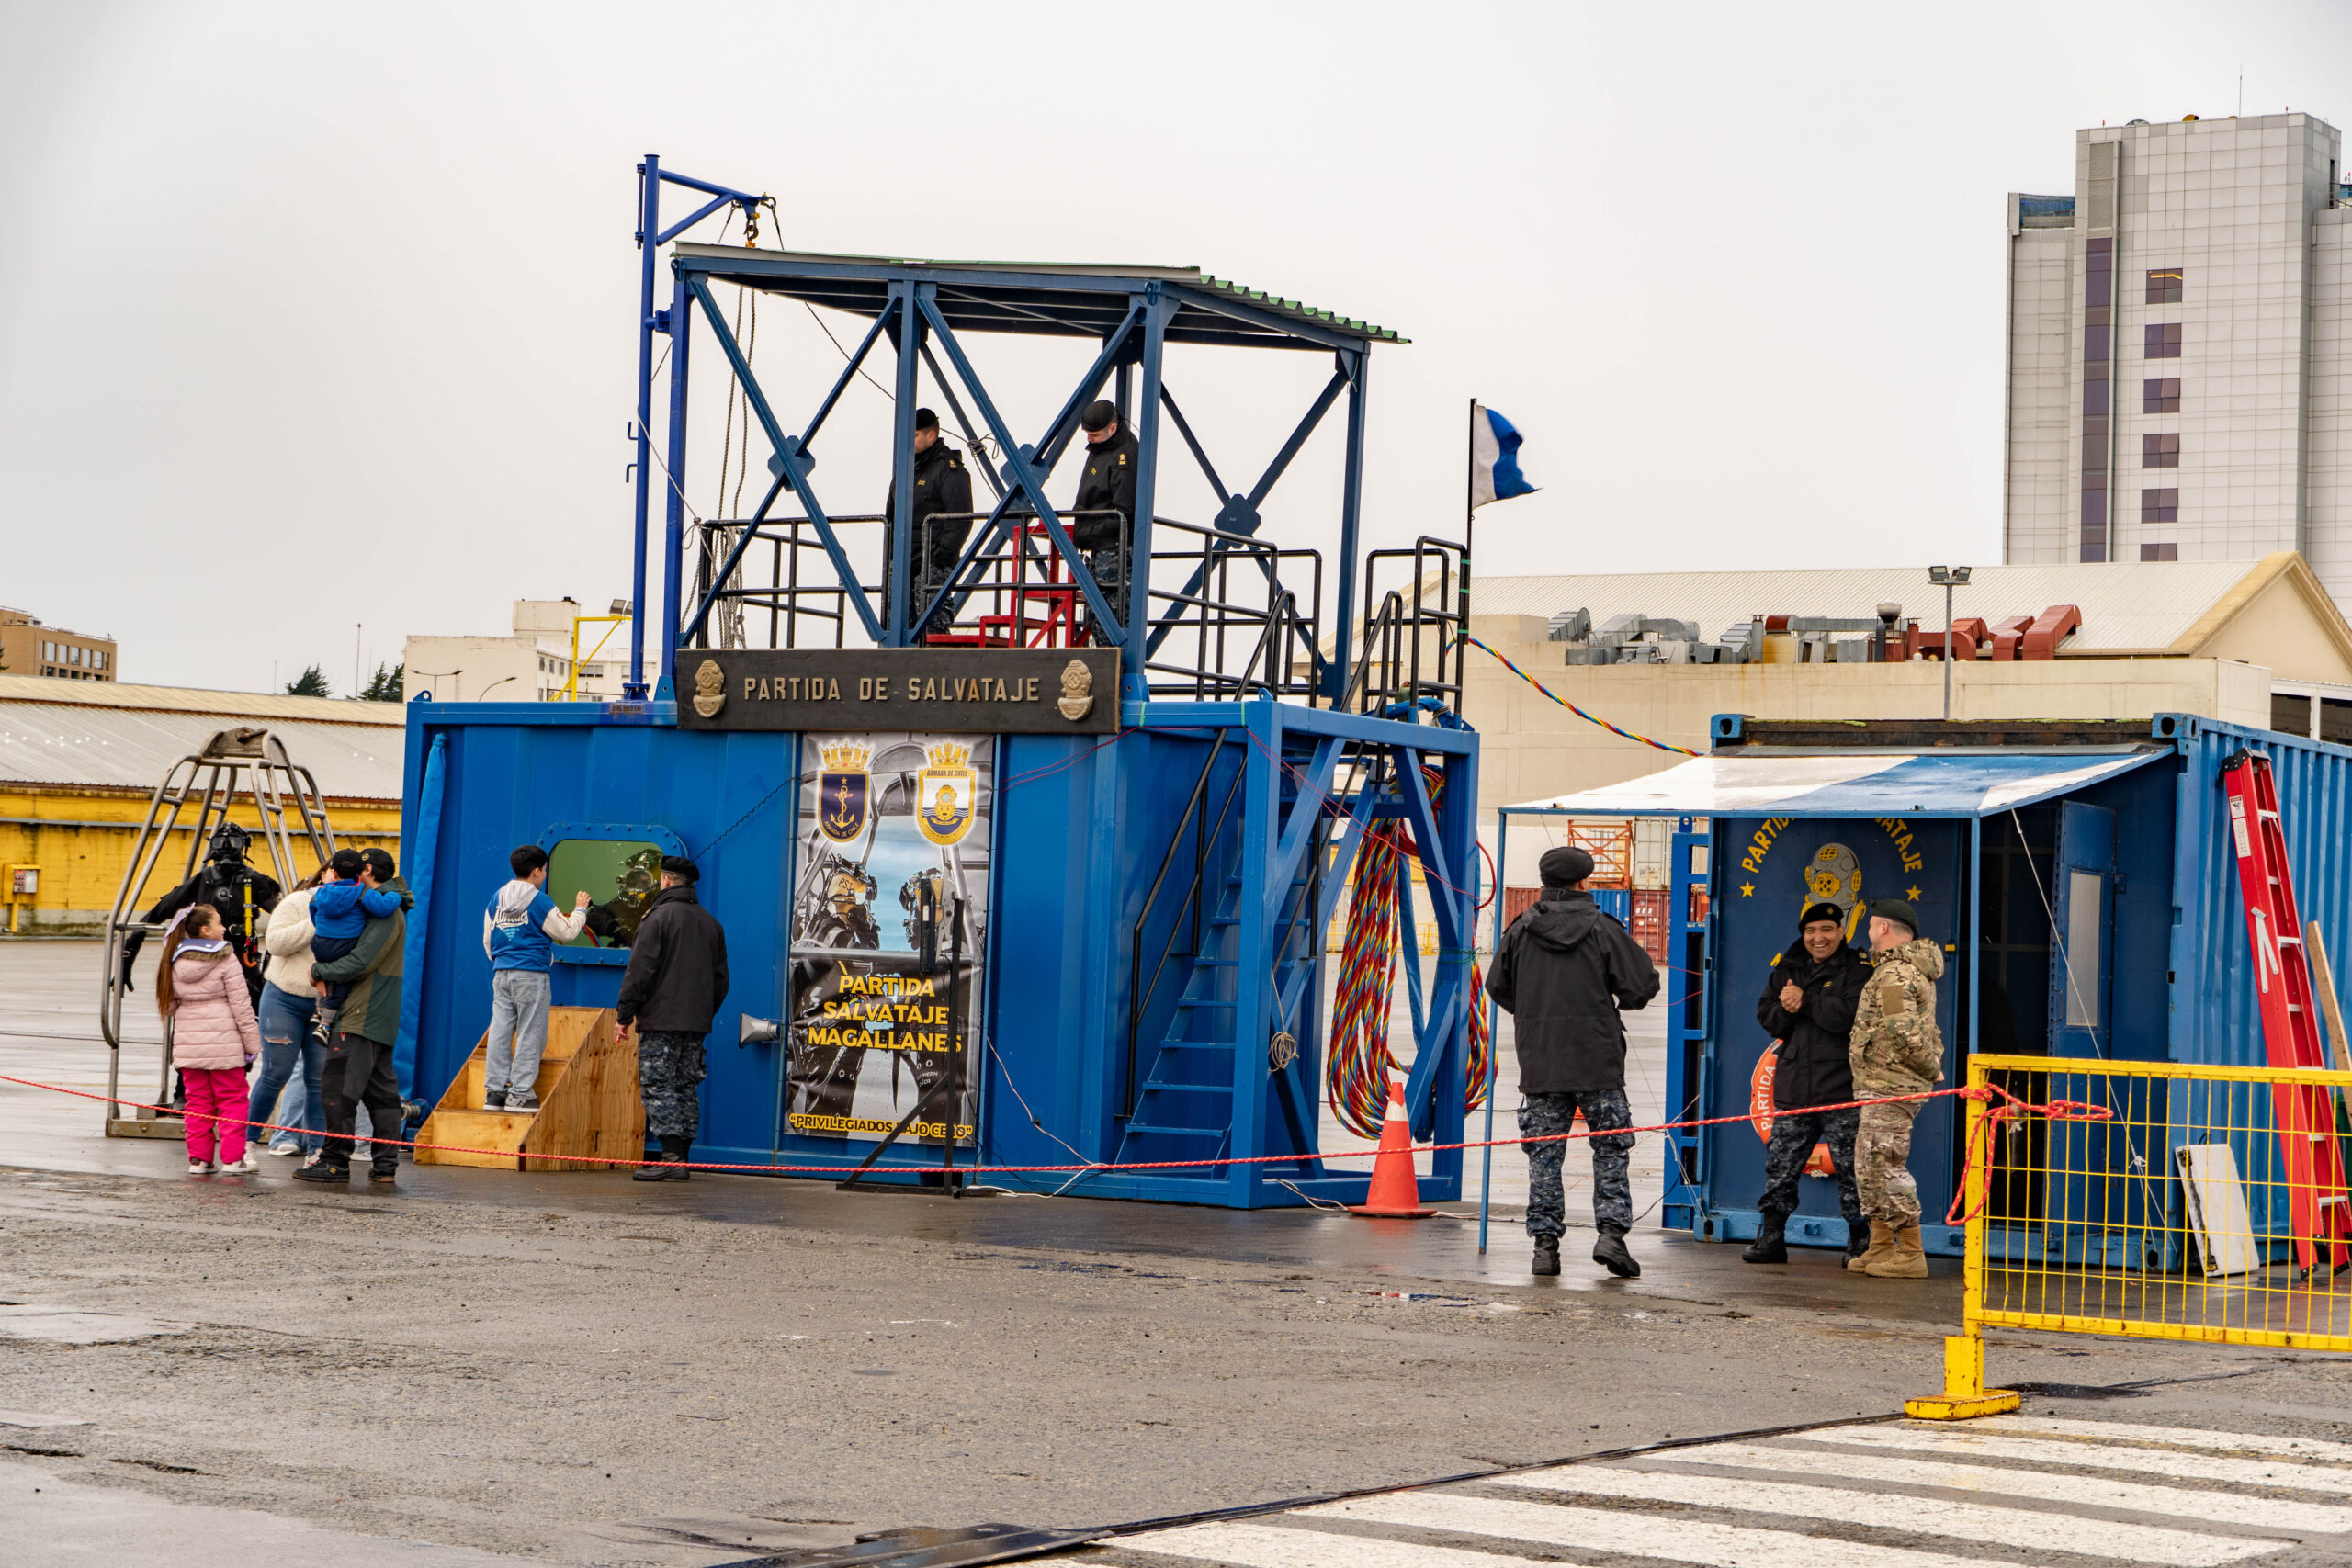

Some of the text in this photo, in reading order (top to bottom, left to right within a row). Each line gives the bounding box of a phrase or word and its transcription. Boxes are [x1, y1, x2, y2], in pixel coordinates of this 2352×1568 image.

[743, 677, 1040, 702] PARTIDA DE SALVATAJE
[1741, 818, 1796, 874] PARTID
[838, 976, 935, 998] PARTIDA
[823, 1001, 950, 1025] SALVATAJE
[896, 1122, 930, 1136] AJO
[930, 1123, 972, 1139] CEO”
